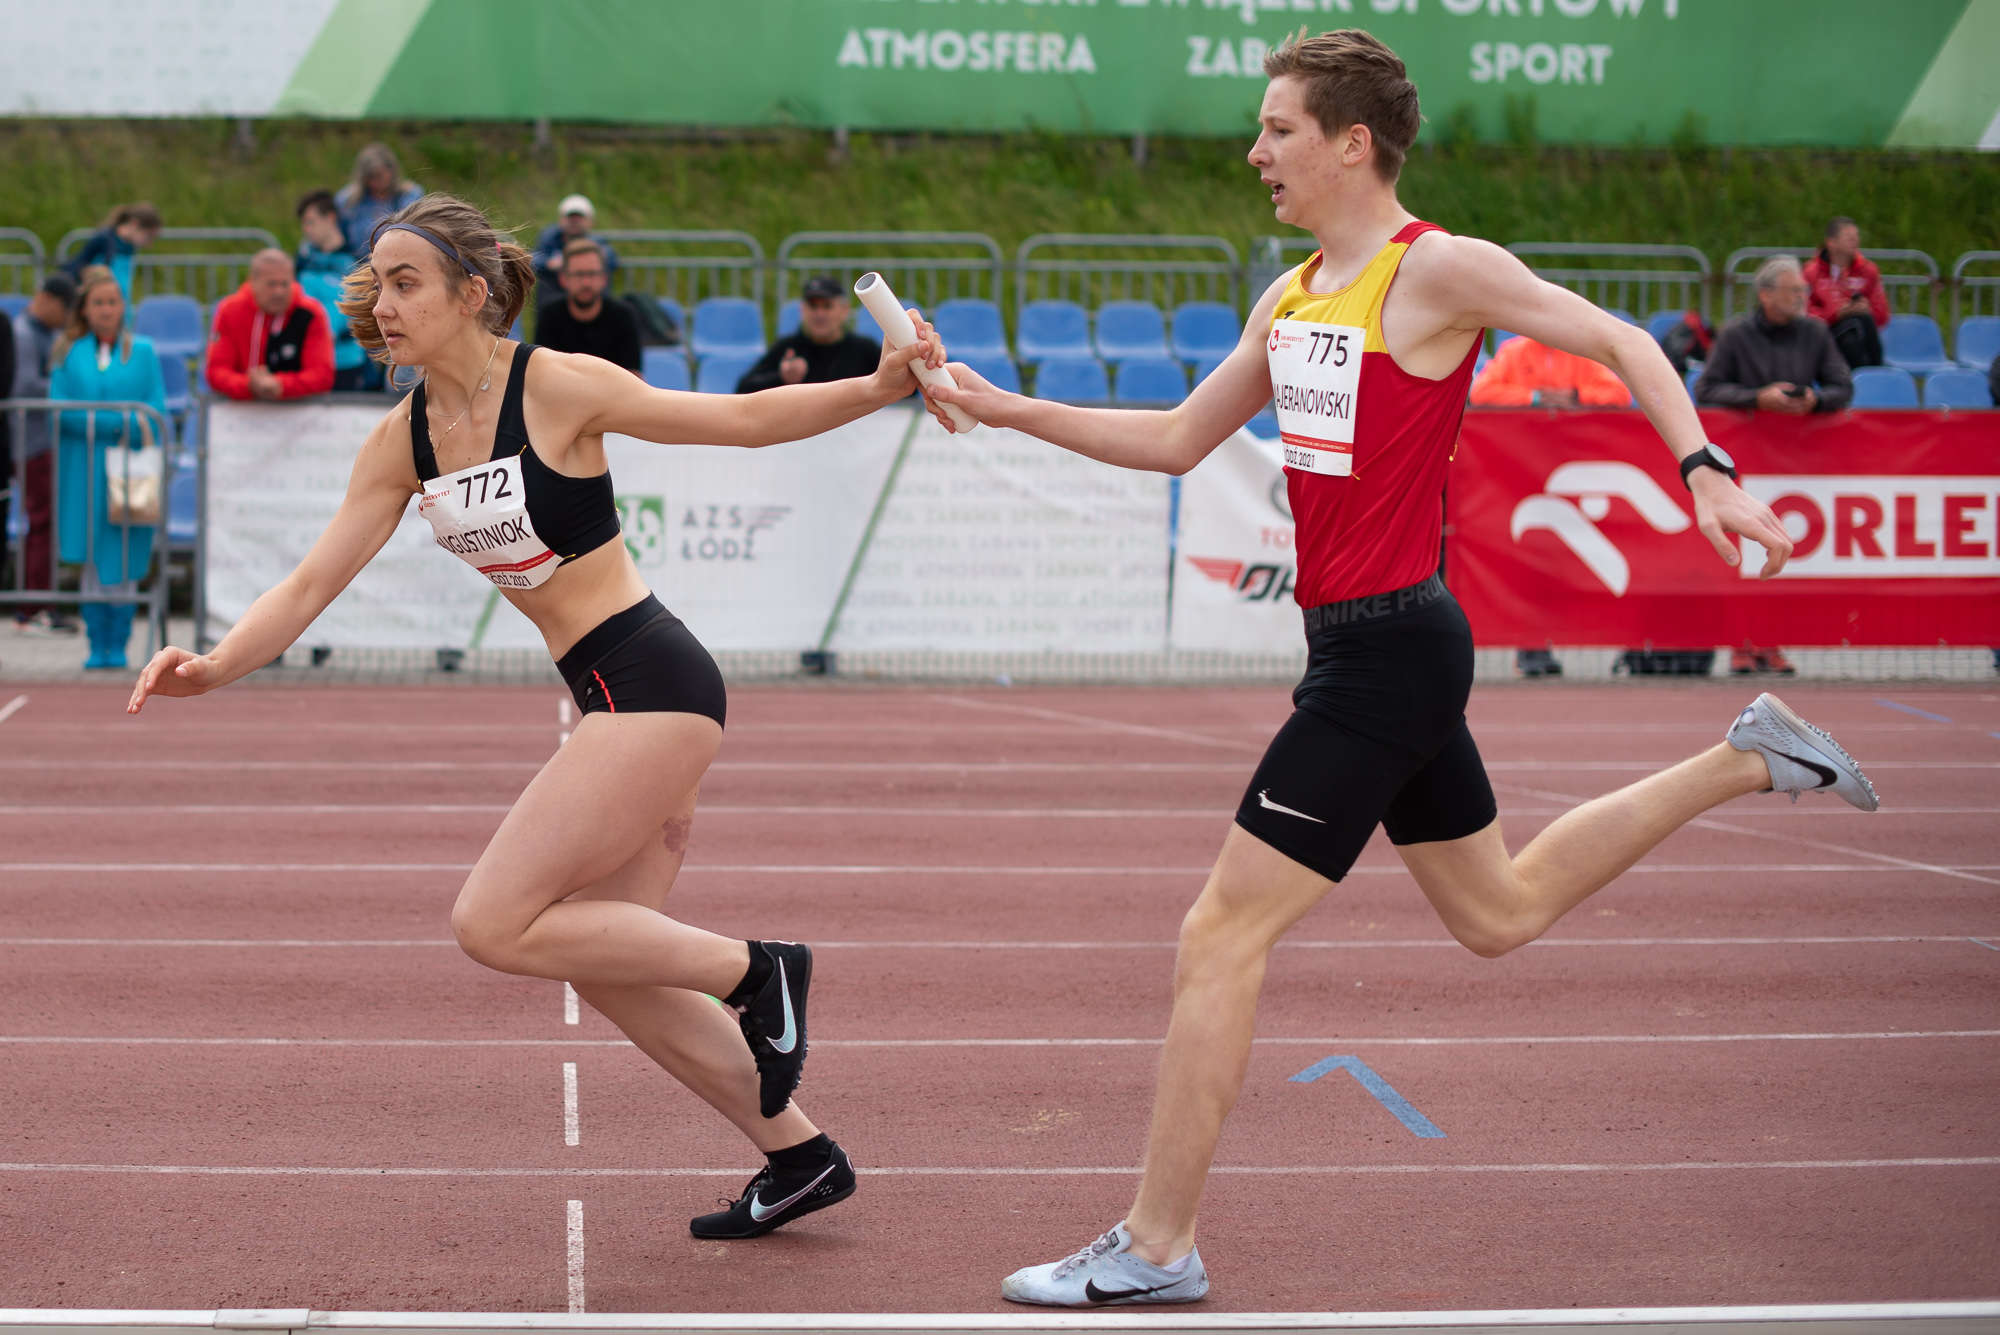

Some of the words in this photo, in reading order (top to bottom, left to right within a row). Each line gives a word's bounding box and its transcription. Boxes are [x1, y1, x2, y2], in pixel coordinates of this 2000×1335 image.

[837, 27, 1097, 74] ATMOSFERA
[1469, 41, 1614, 85] SPORT
[1307, 331, 1349, 367] 775
[1274, 383, 1350, 420] AJERANOWSKI
[1299, 451, 1315, 469] 2021
[456, 467, 513, 509] 772
[682, 505, 743, 529] AZS
[1766, 491, 2000, 562] ORLE
[510, 574, 532, 586] 2021
[1322, 592, 1391, 627] NIKE
